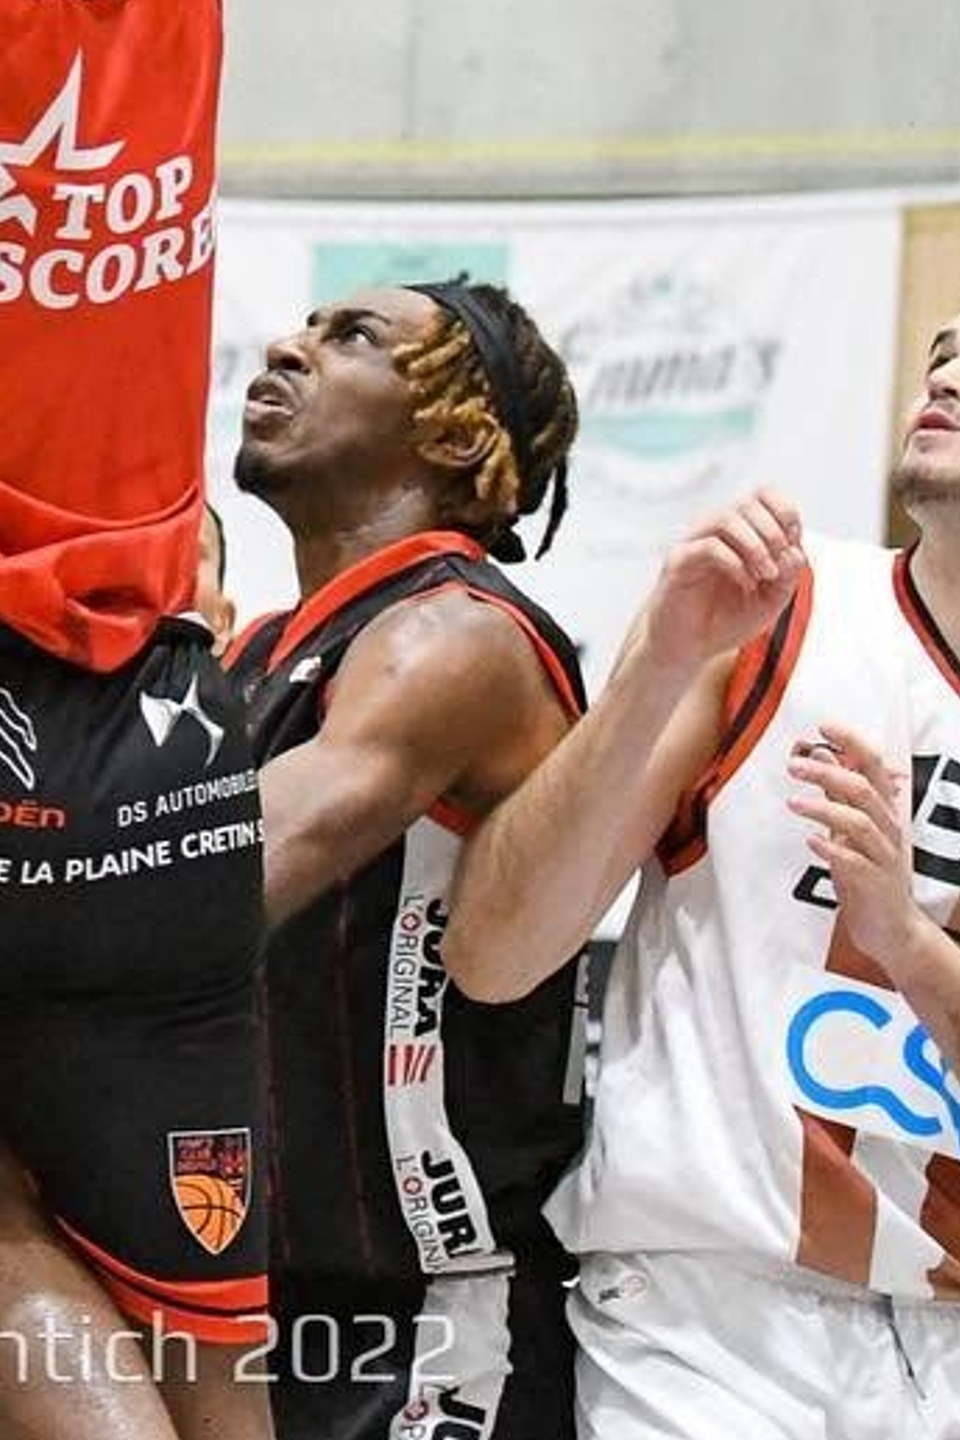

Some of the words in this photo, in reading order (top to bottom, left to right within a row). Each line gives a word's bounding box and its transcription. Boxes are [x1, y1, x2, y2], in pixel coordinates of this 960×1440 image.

[53, 155, 193, 240] TOP
[117, 800, 149, 828] DS
[21, 860, 54, 885] LA
[65, 840, 172, 882] PLAINE
[420, 1150, 482, 1258] JUR
